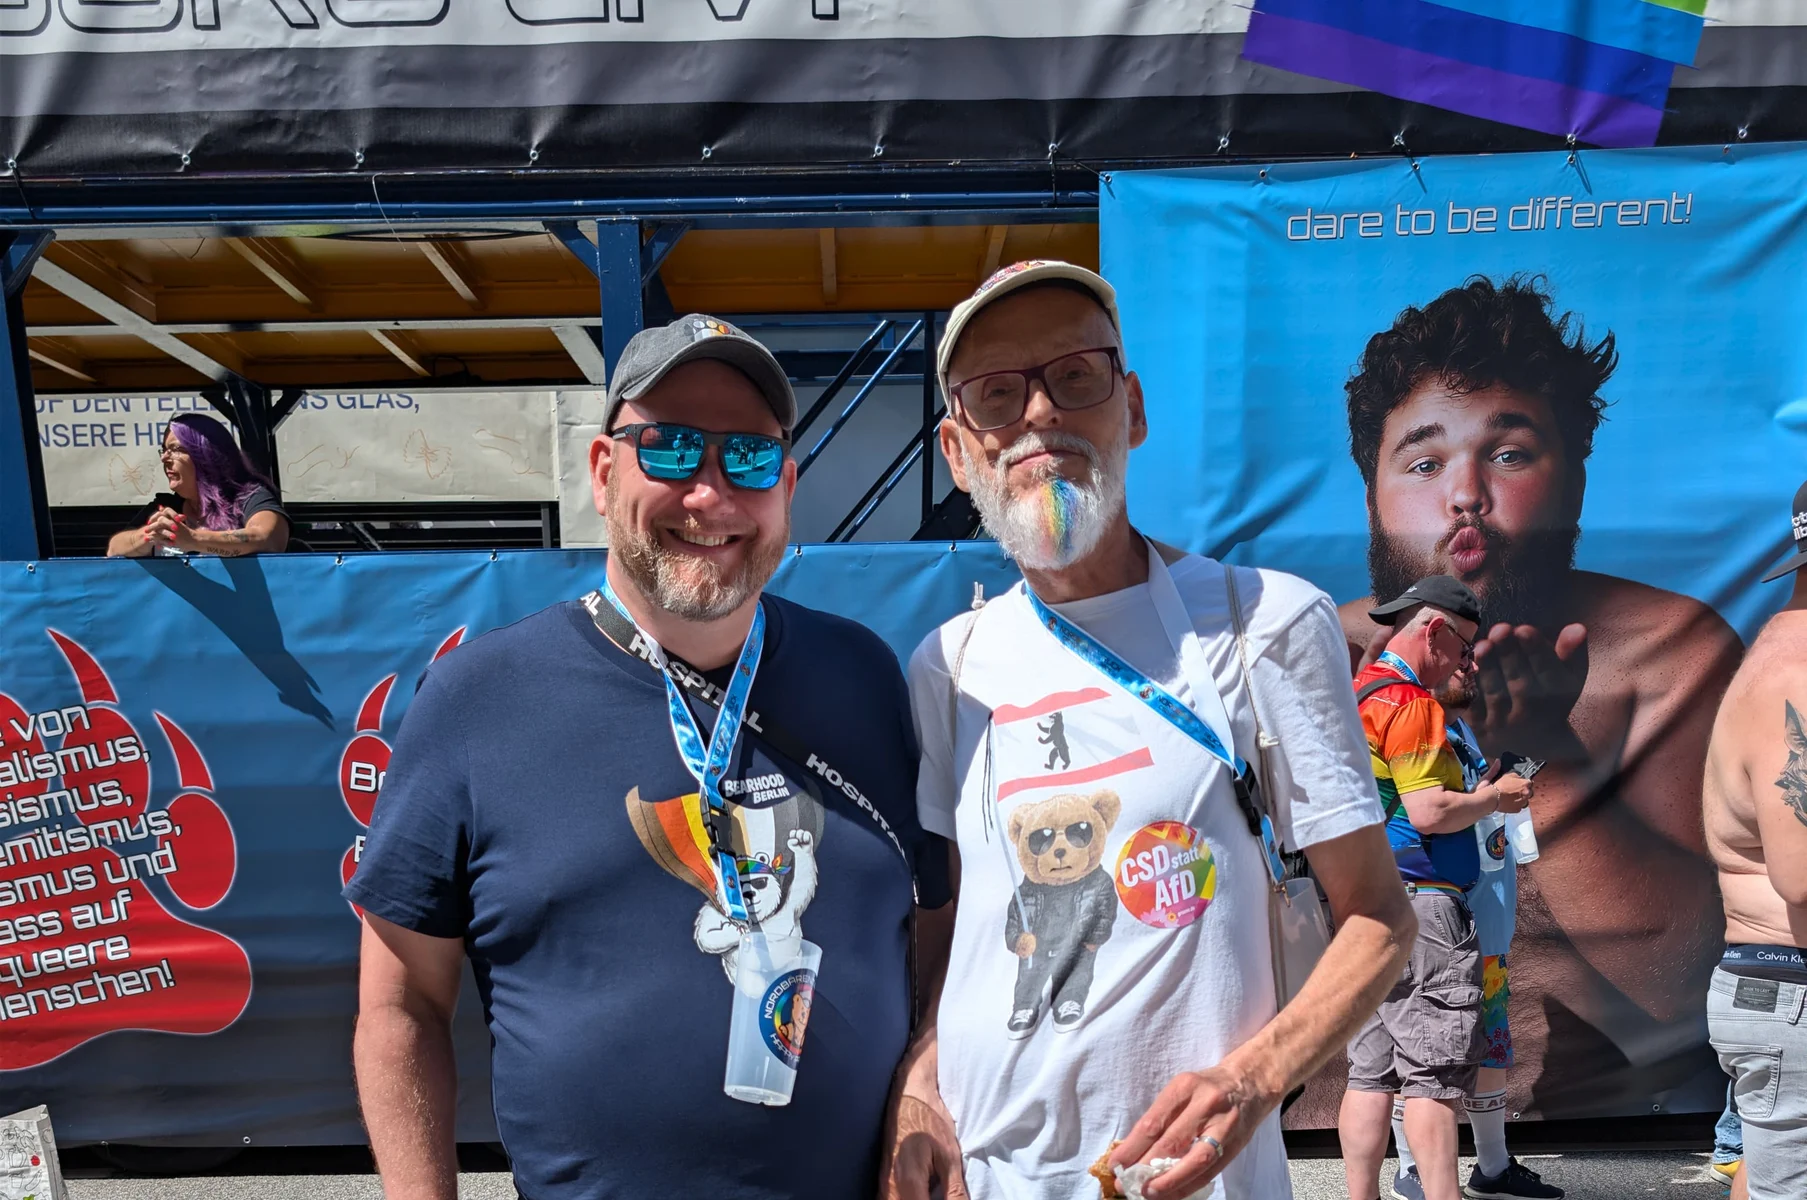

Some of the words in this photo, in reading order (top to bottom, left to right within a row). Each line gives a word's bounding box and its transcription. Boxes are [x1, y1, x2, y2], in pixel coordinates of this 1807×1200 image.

[1287, 207, 1383, 241] dare
[1395, 203, 1435, 236] to
[1447, 201, 1497, 234] be
[1508, 191, 1693, 231] different!
[628, 633, 764, 734] HOSPITL
[9, 705, 91, 742] von
[0, 736, 150, 787] alismus,
[724, 773, 785, 797] BEARHOOD
[753, 786, 790, 804] BERLIN
[104, 841, 178, 884] und
[1121, 844, 1170, 888] CSD
[1171, 847, 1201, 869] statt
[71, 889, 132, 929] auf
[1155, 869, 1196, 911] AfD
[0, 935, 131, 988] queere
[1756, 951, 1788, 962] Calvin
[1790, 954, 1807, 964] Kle
[0, 959, 176, 1021] enschen!
